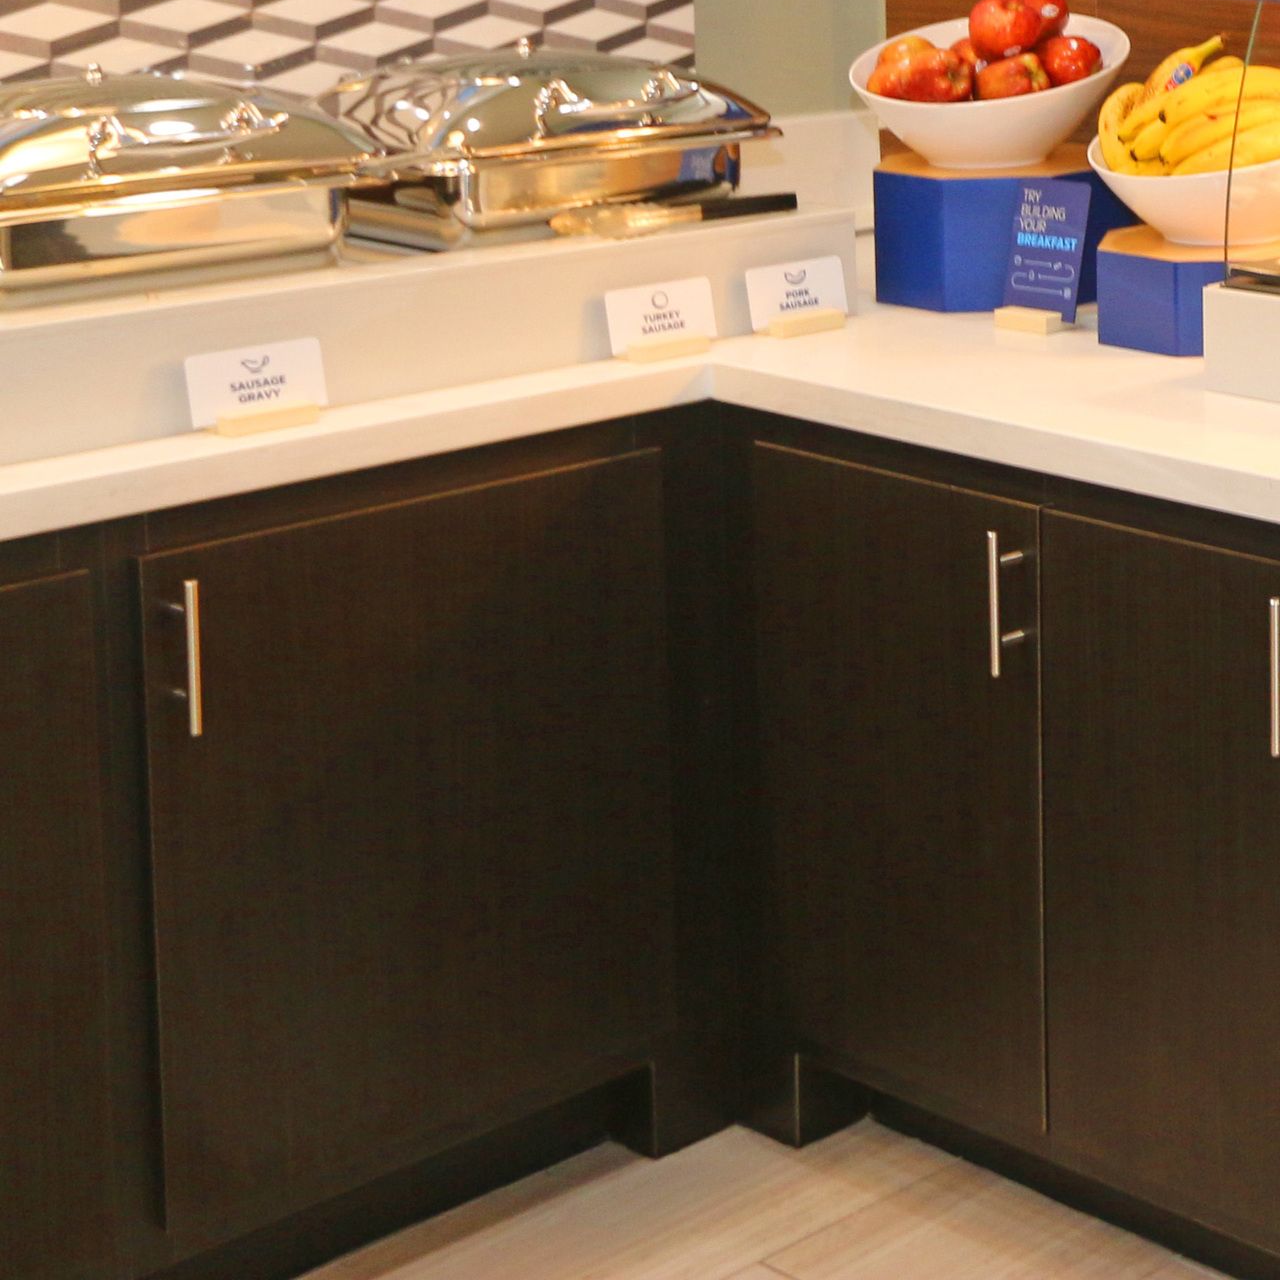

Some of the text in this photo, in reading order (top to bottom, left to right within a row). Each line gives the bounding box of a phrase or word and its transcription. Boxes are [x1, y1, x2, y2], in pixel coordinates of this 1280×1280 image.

[1023, 188, 1042, 203] TRY
[1021, 204, 1066, 221] BUILDING
[1019, 218, 1046, 233] YOUR
[1017, 232, 1078, 252] BREAKFAST
[785, 288, 810, 300] PORK
[779, 297, 820, 312] SAUSAGE
[643, 310, 681, 324] TURKEY
[641, 320, 686, 335] SAUSAGE
[229, 375, 287, 392] SAUSAGE
[238, 389, 281, 403] GRAVY
